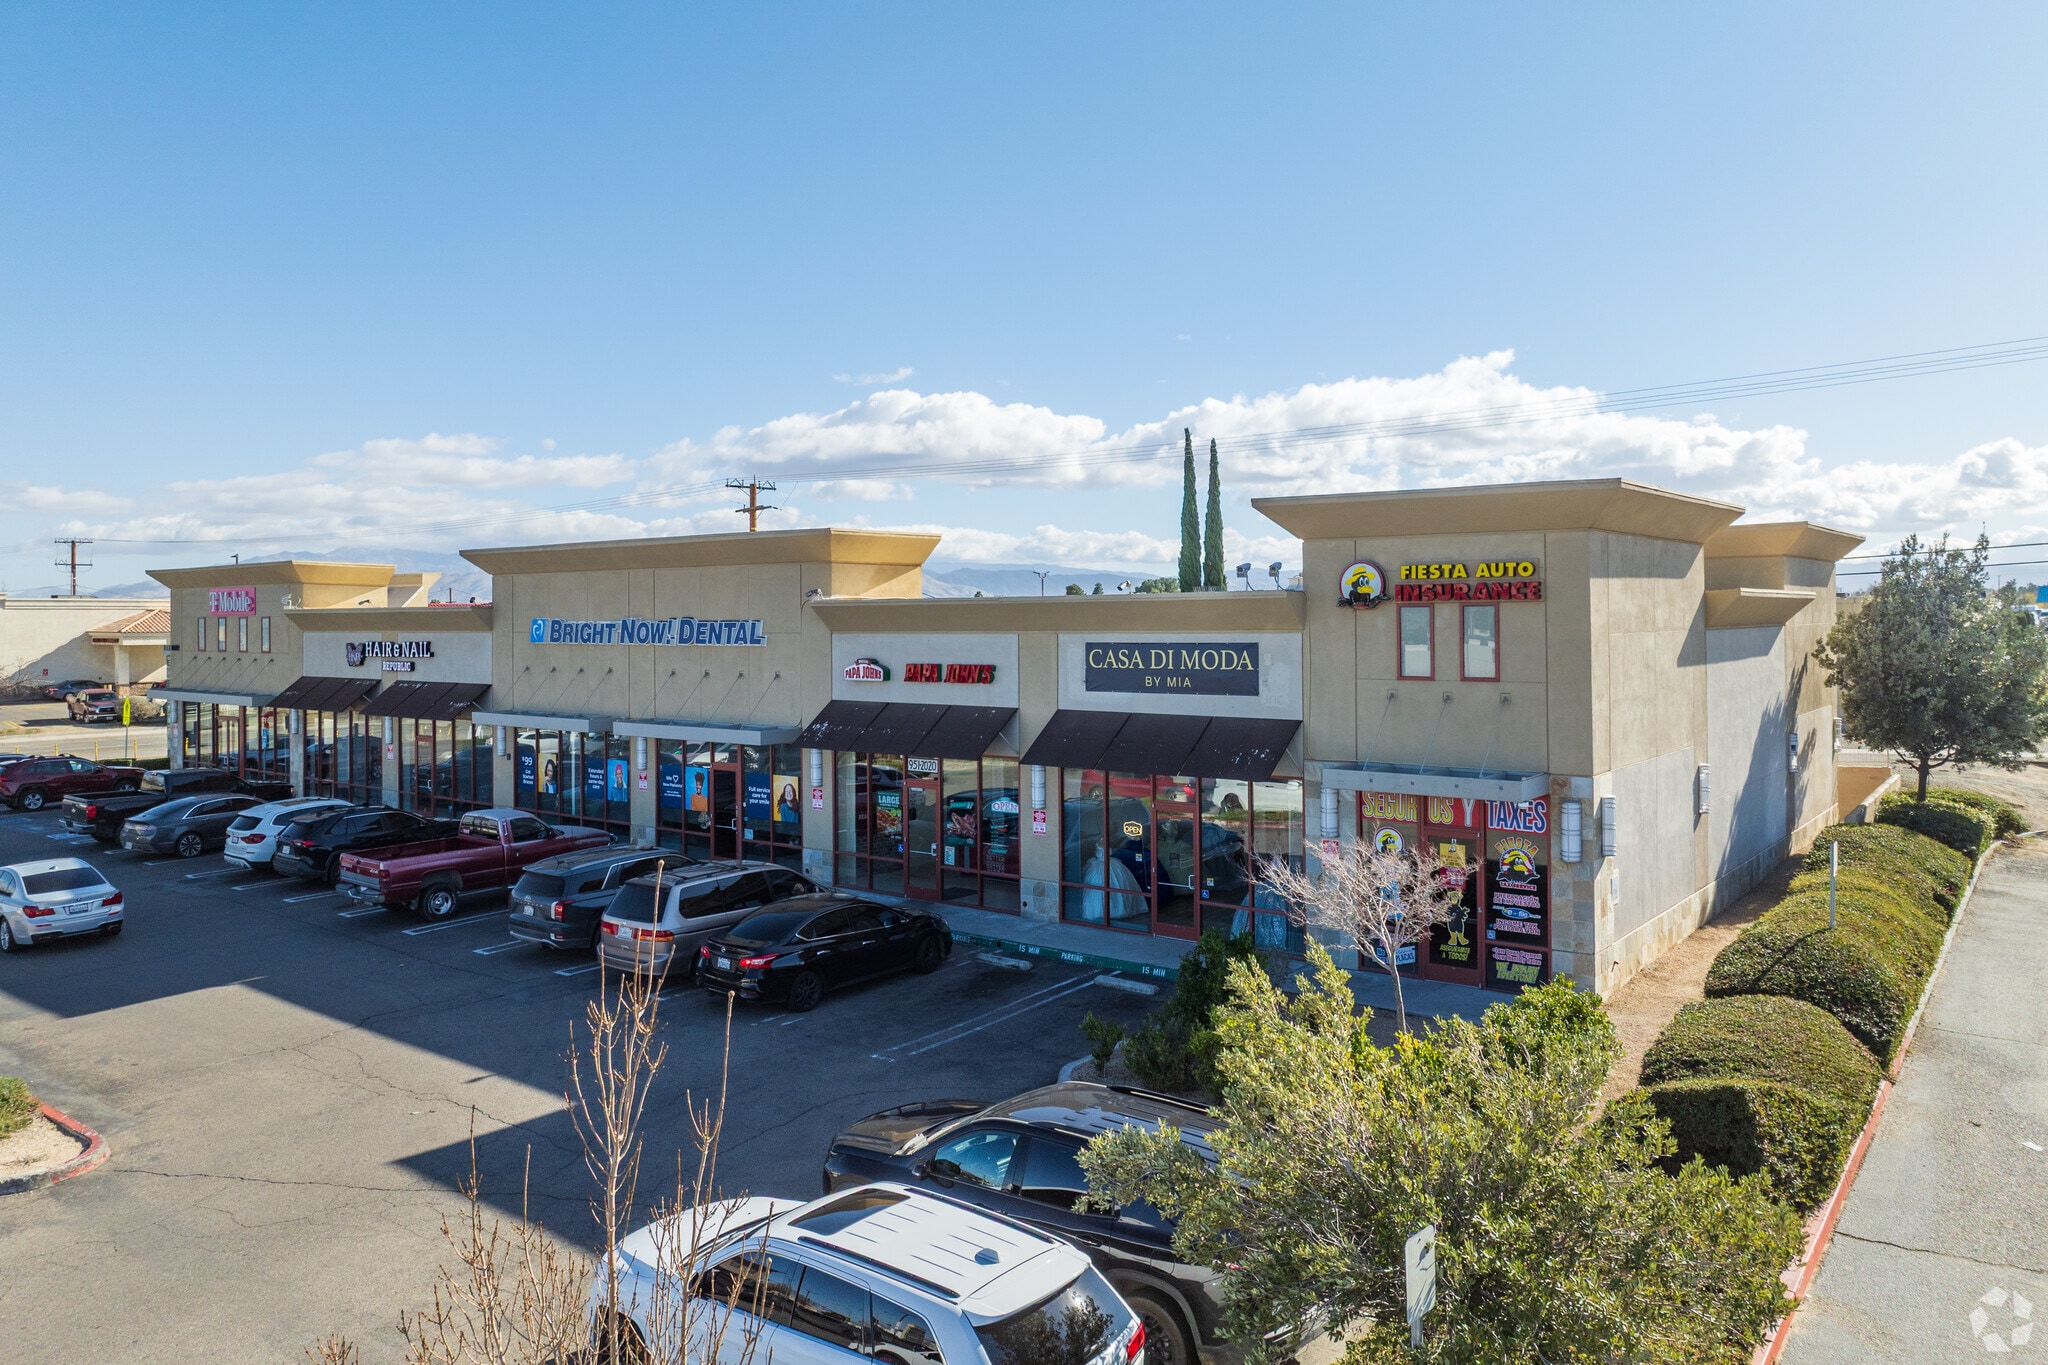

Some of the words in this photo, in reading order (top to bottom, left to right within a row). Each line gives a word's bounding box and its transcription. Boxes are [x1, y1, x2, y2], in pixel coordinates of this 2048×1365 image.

[1401, 563, 1467, 580] FIESTA
[1475, 561, 1535, 578] AUTO
[1395, 581, 1542, 602] INSURANCE
[209, 591, 250, 612] T-Mobile
[365, 641, 392, 657] HAIR
[401, 641, 431, 658] NAIL
[382, 661, 411, 671] REPUBLIC
[1089, 649, 1145, 669] CASA
[1150, 649, 1175, 670] DI
[1180, 650, 1255, 671] MODA
[845, 666, 861, 679] PAPA
[862, 665, 882, 680] JOHNS
[904, 663, 941, 683] PAPA
[944, 664, 995, 684] JOHN'S
[1145, 676, 1161, 687] BY
[1167, 676, 1192, 688] MIA
[878, 795, 900, 805] LARGE
[993, 801, 1018, 813] OPEN
[1485, 800, 1547, 833] TAXES
[1124, 825, 1142, 834] OPEN
[1018, 944, 1026, 953] 15
[1028, 946, 1040, 955] MIN
[1061, 952, 1084, 963] PARKING
[1142, 965, 1150, 974] 15
[1153, 968, 1166, 977] MIN
